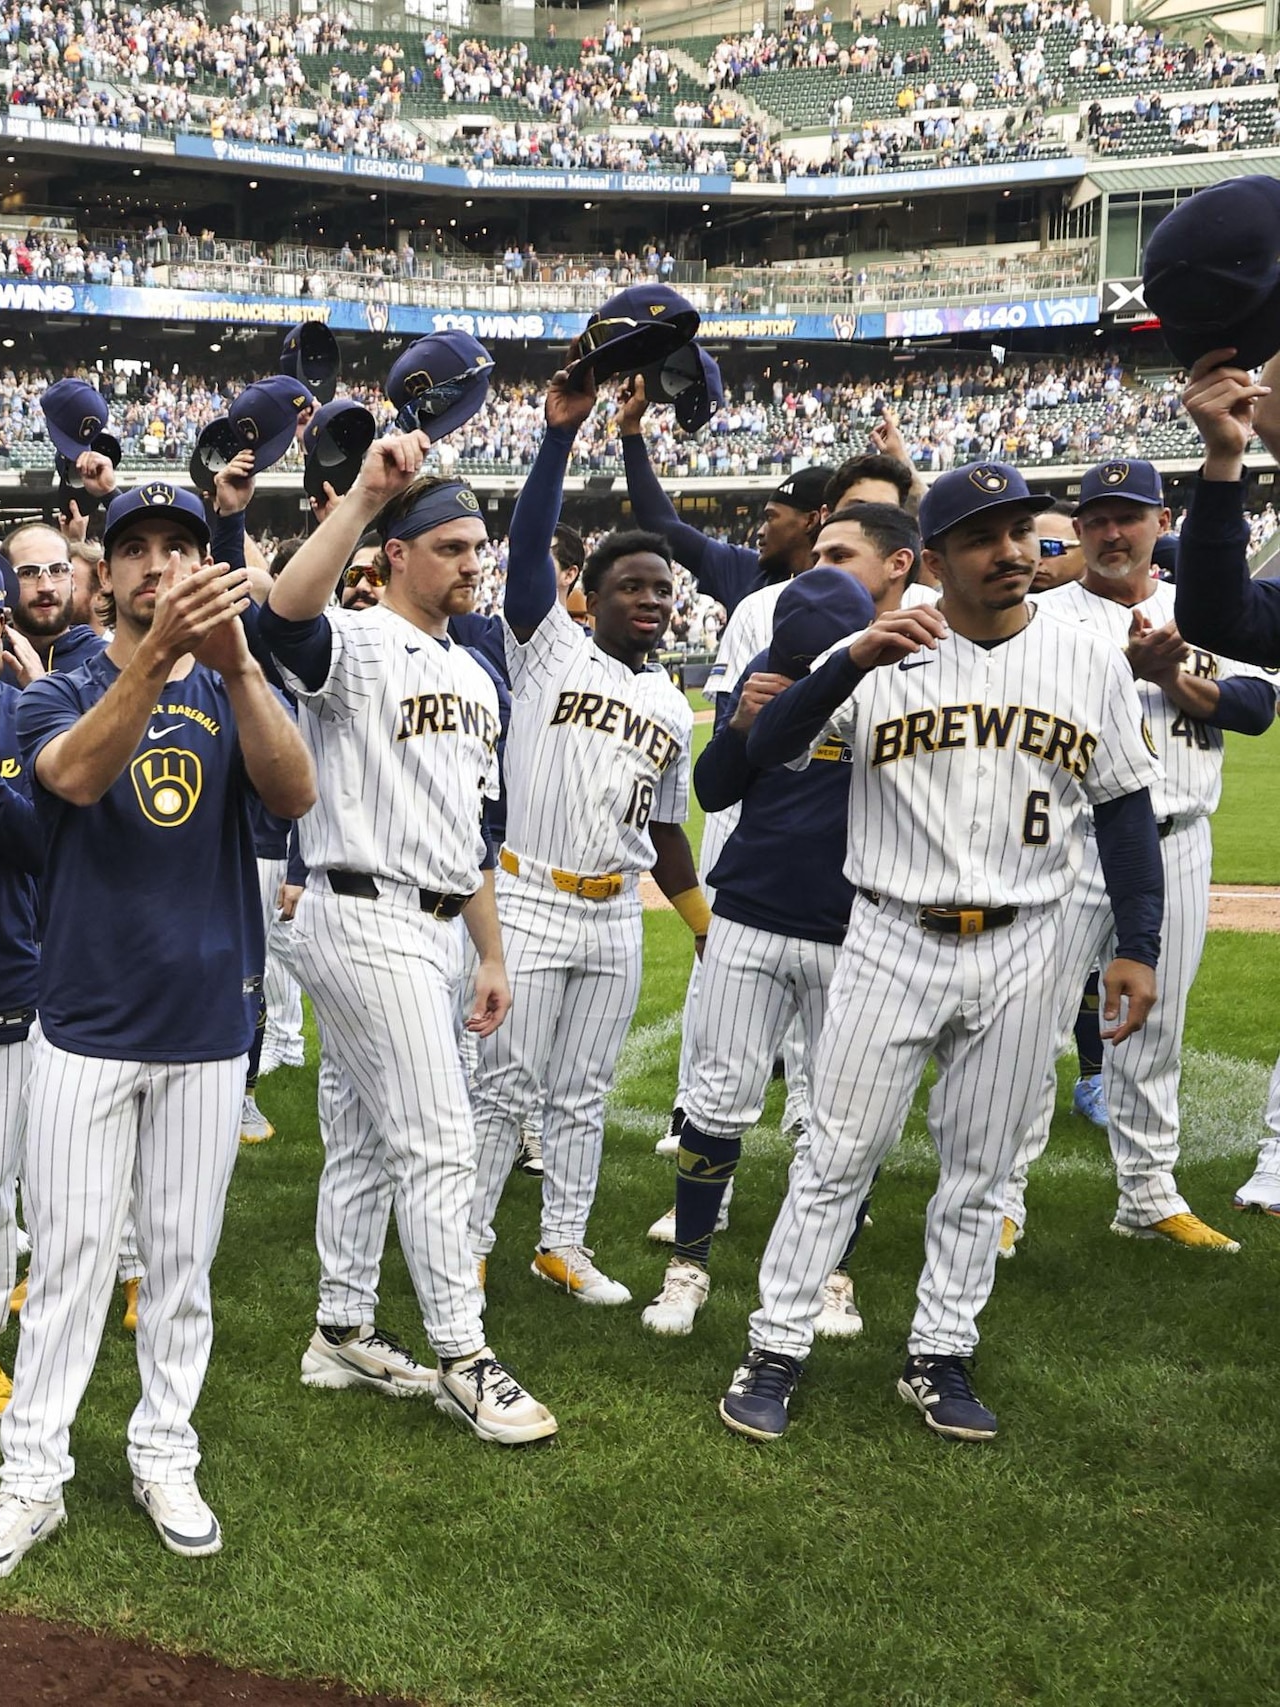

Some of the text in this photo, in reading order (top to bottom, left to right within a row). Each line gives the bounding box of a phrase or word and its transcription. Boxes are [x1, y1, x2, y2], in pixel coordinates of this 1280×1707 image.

[228, 143, 304, 167] Northwestern
[354, 158, 398, 179] LEGENDS
[399, 162, 424, 181] CLUB
[838, 167, 1015, 192] FLECHA AZUL TEQUILA PATIO
[483, 171, 566, 188] Northwestern
[622, 175, 671, 191] LEGENDS
[672, 177, 700, 192] CLUB
[432, 313, 545, 339] 103 WINS
[750, 319, 796, 336] HISTORY
[962, 306, 1027, 330] 4:40
[167, 704, 221, 736] BASEBALL
[397, 693, 499, 754] BREWE
[550, 691, 683, 772] BREWER
[872, 702, 1098, 782] BREWERS
[623, 780, 653, 833] 18
[1022, 790, 1051, 846] 6
